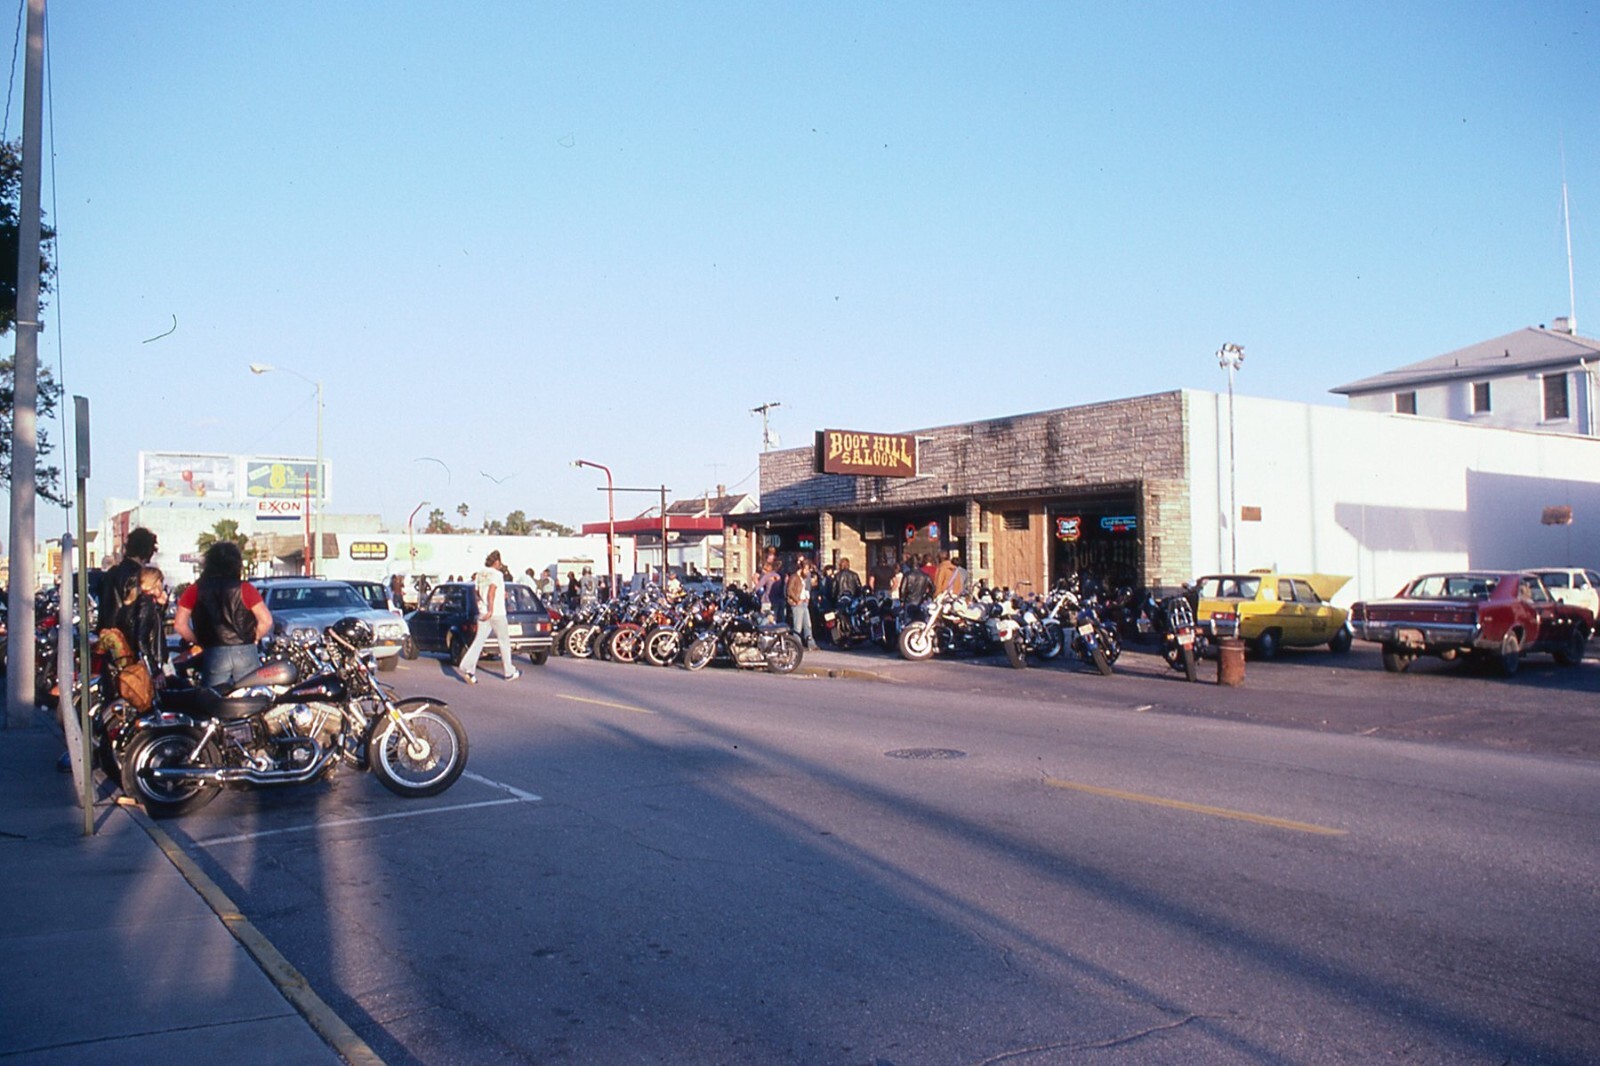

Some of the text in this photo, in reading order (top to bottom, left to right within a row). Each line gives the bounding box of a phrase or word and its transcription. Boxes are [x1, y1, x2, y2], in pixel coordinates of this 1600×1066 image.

[829, 432, 912, 468] BOOT HILL
[841, 449, 898, 467] SALOON
[258, 500, 301, 514] EXXON
